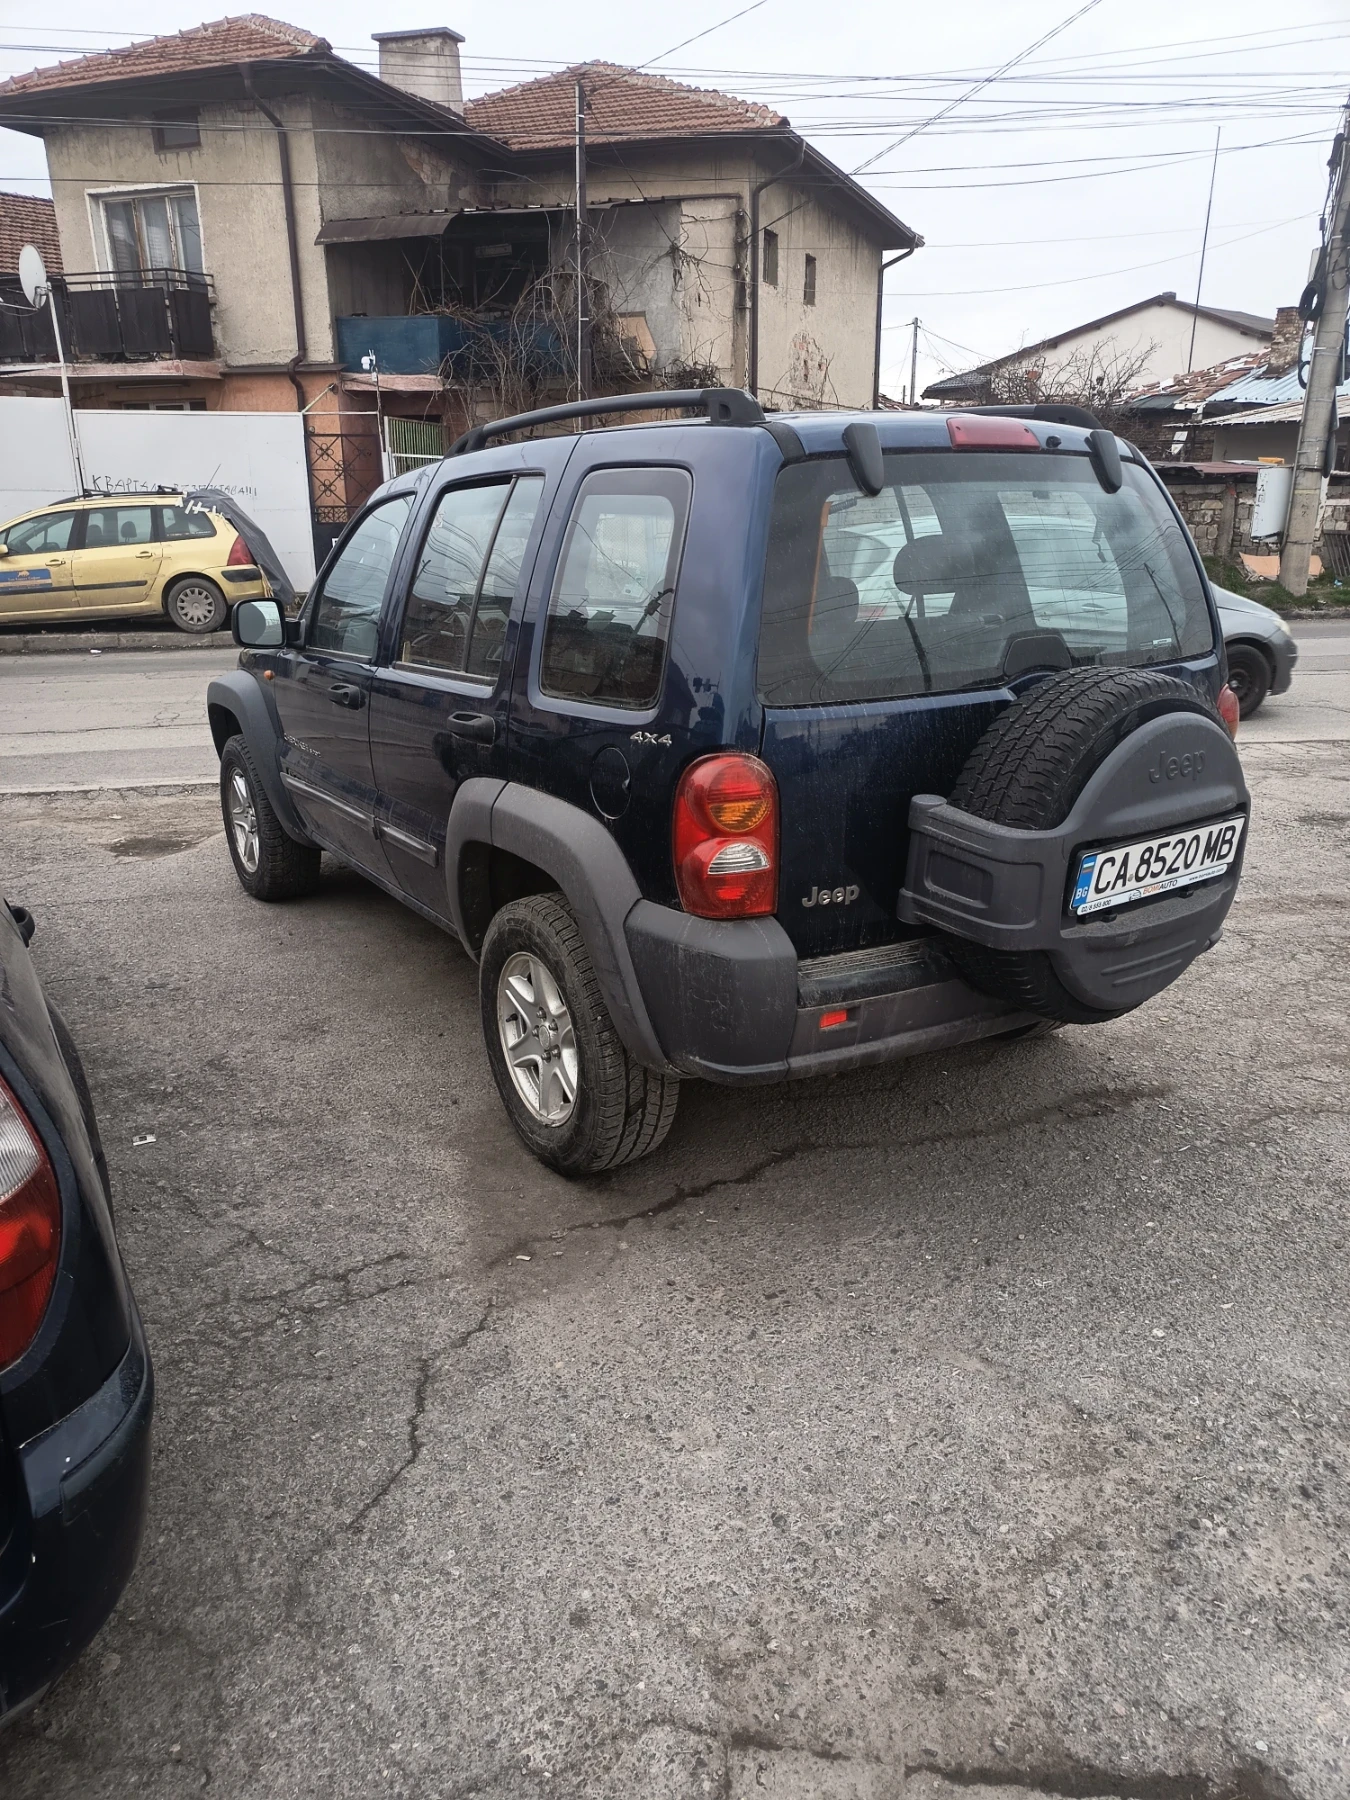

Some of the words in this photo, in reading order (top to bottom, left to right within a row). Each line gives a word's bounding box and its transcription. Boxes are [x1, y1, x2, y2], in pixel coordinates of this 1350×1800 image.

[1149, 750, 1206, 783] Jeep
[1094, 852, 1129, 894] CA
[1134, 834, 1200, 883] 8520
[1200, 825, 1236, 866] MB
[801, 884, 860, 908] Jeep
[1075, 887, 1089, 899] BG
